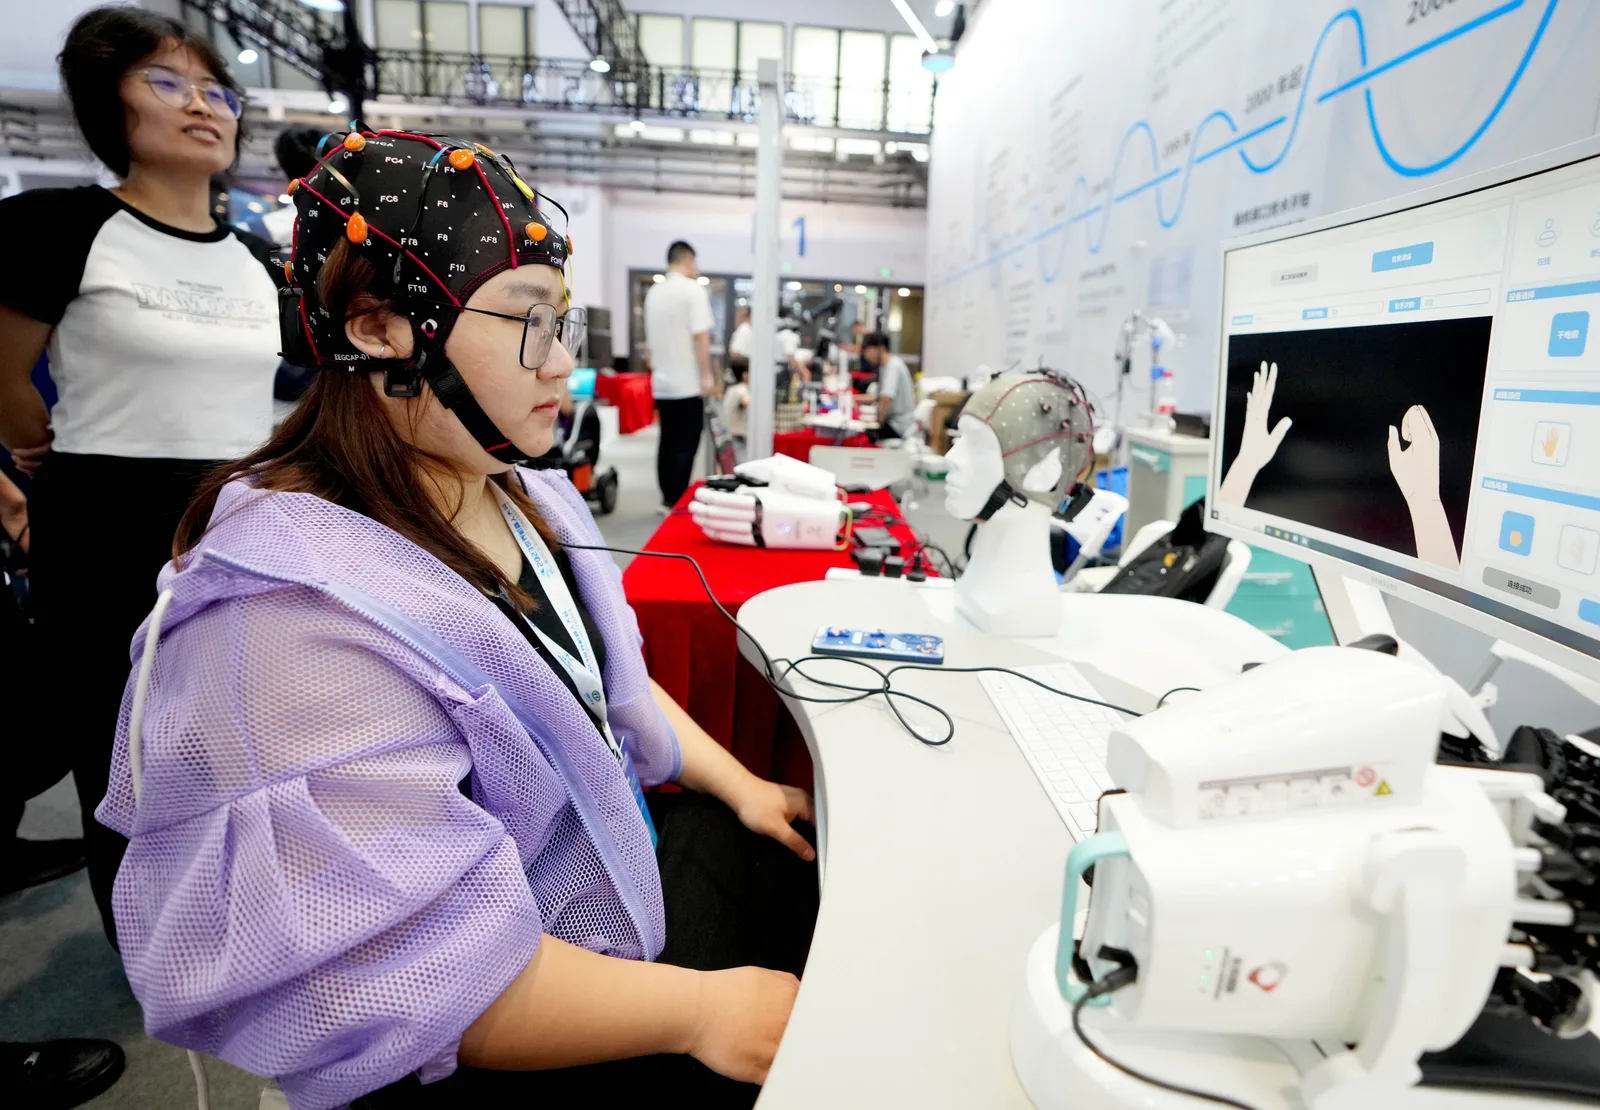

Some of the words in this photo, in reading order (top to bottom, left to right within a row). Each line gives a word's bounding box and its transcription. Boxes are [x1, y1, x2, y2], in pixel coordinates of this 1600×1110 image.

[385, 156, 404, 164] FC4
[444, 166, 456, 174] F4
[380, 195, 399, 203] FC6
[437, 200, 449, 208] F6
[437, 233, 449, 241] F8
[480, 235, 498, 244] AF8
[449, 263, 465, 272] F10
[407, 284, 428, 293] FT10
